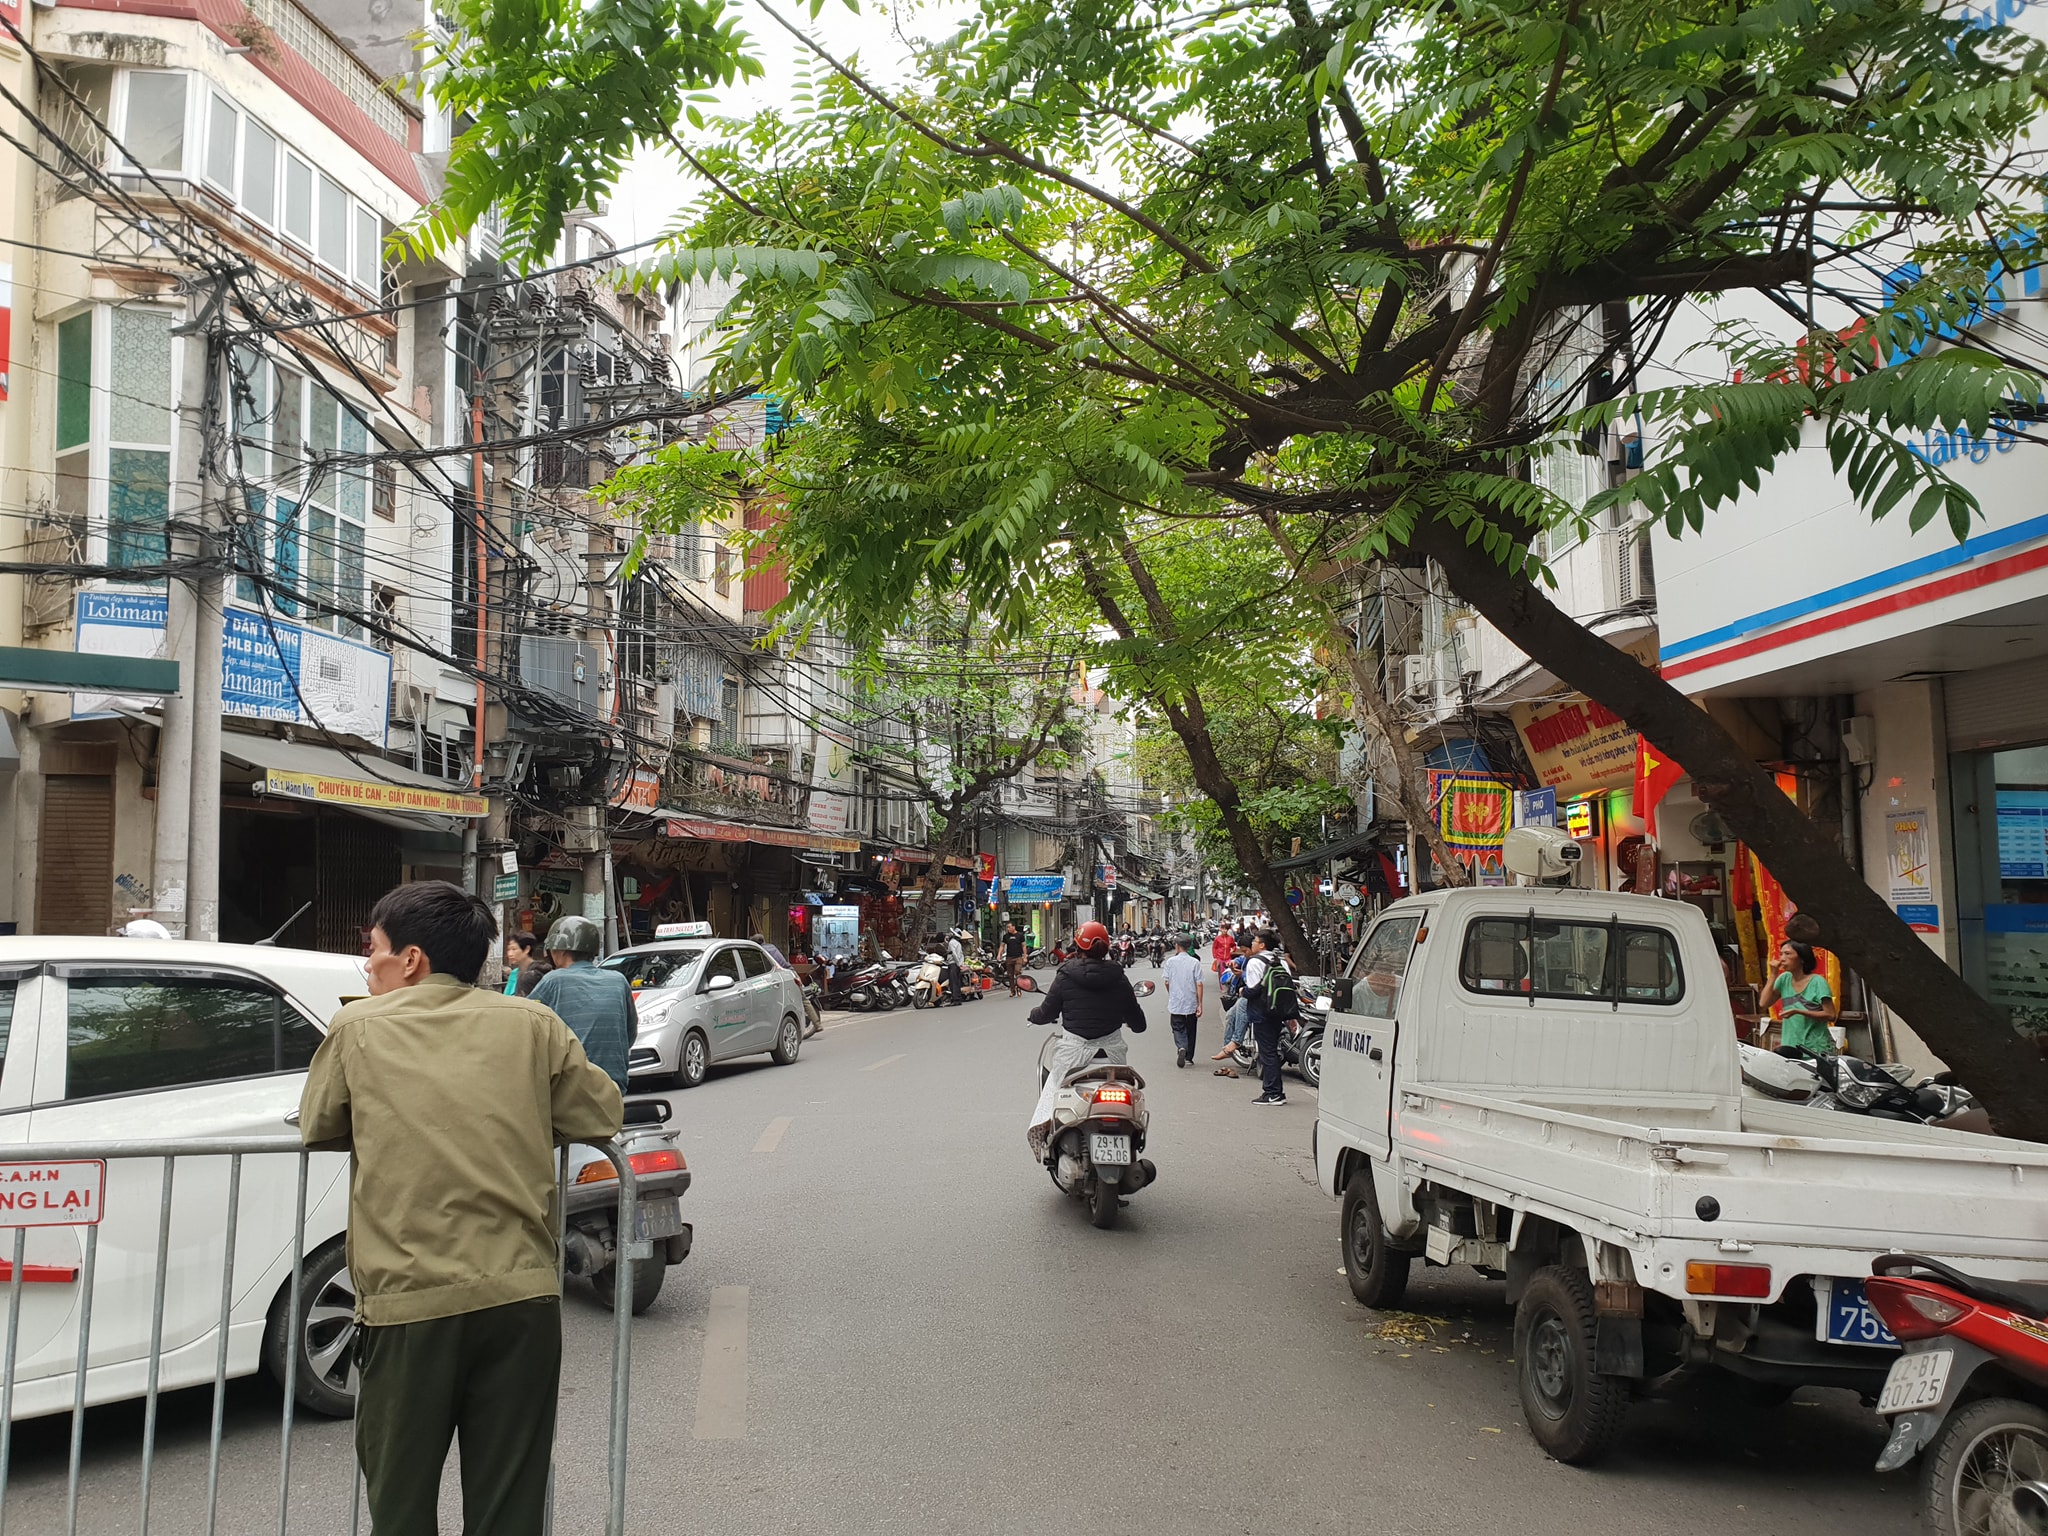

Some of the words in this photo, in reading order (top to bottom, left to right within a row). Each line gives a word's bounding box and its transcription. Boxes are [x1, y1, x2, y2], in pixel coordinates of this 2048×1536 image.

[88, 601, 168, 621] Lohman
[318, 781, 351, 797] CHUYÊN
[365, 787, 382, 800] CAN
[407, 791, 422, 805] DÁN
[424, 793, 440, 808] KÍNH
[1533, 794, 1544, 811] PHỐ
[1354, 1030, 1371, 1055] SÁT
[1097, 1136, 1125, 1149] 29-K1
[1094, 1149, 1128, 1163] 425.06
[0, 1170, 59, 1182] .A.H.N
[44, 1190, 90, 1212] LẠI
[1893, 1354, 1939, 1382] 22-B1
[1881, 1379, 1941, 1409] 307.25
